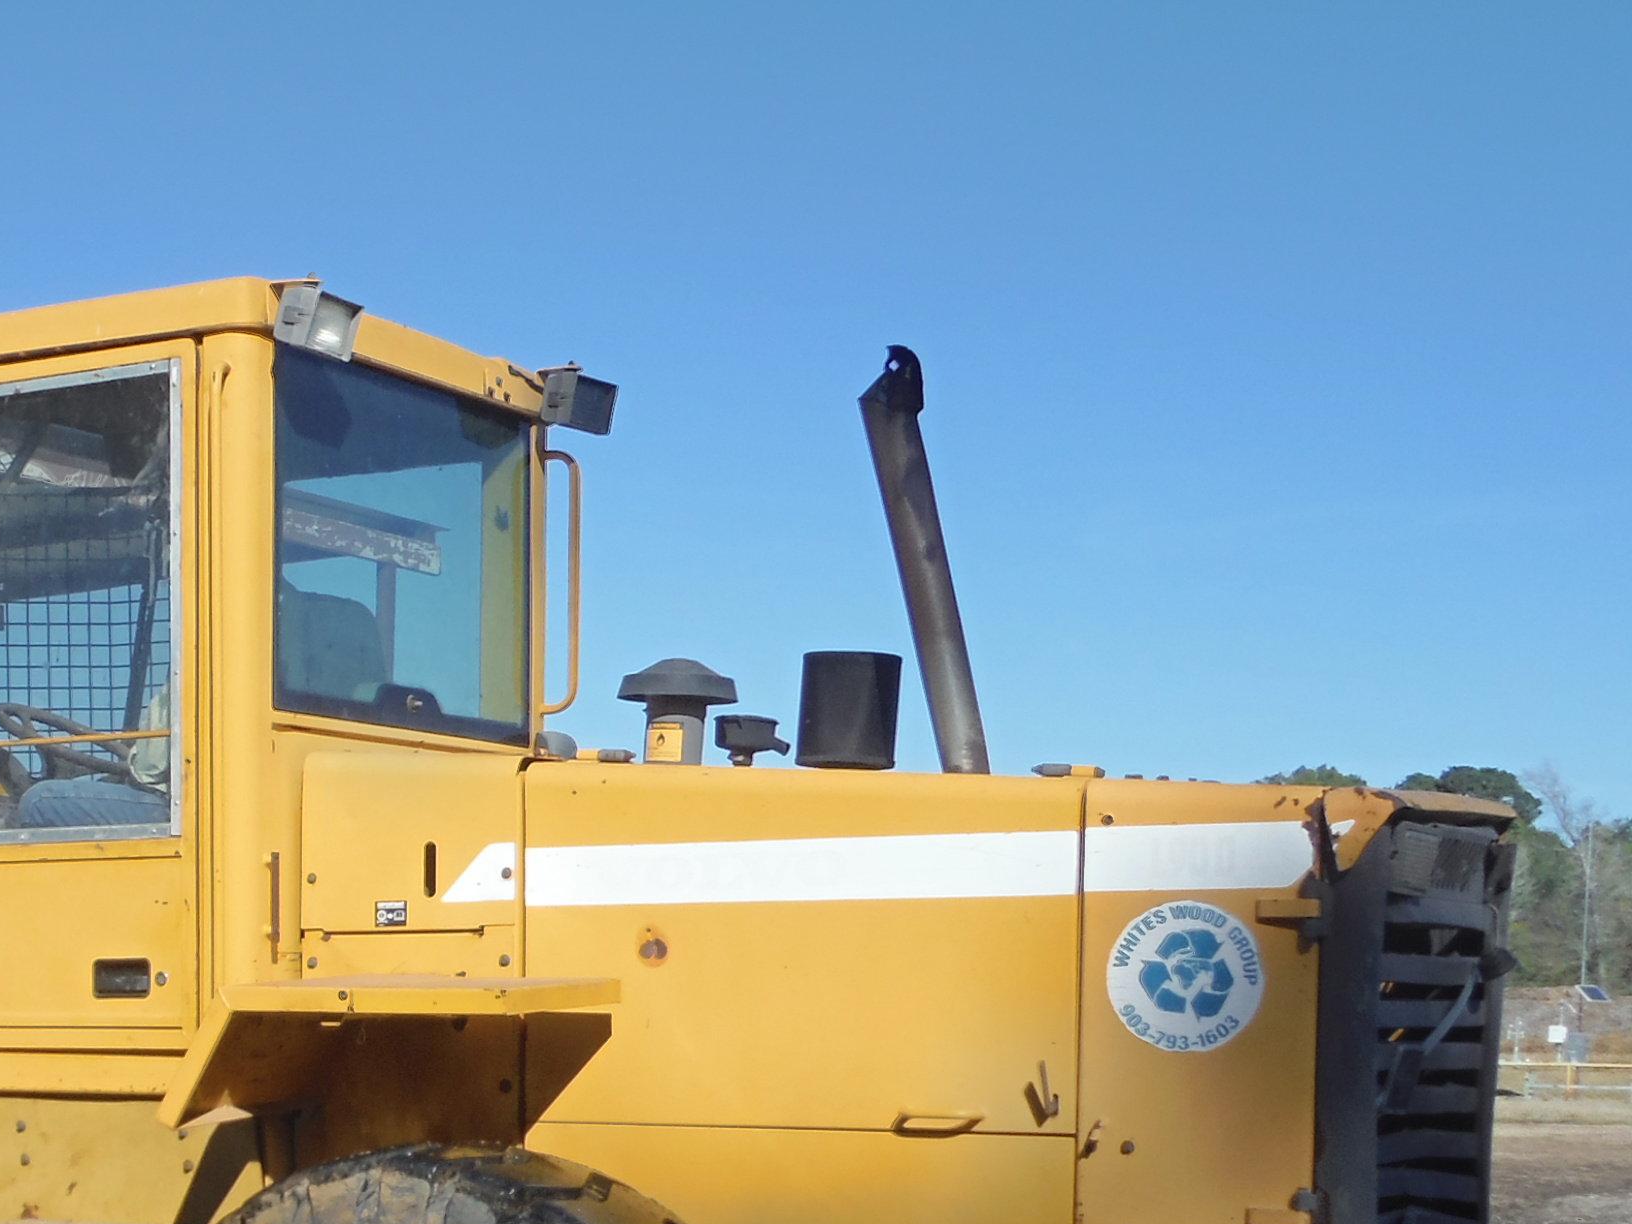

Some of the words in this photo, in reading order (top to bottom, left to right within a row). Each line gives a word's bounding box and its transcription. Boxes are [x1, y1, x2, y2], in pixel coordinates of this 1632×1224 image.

[1114, 909, 1167, 968] WHITES
[1169, 905, 1227, 928] WOOD
[1228, 926, 1258, 985] GROUP
[1120, 1004, 1239, 1050] 903-793-1603
